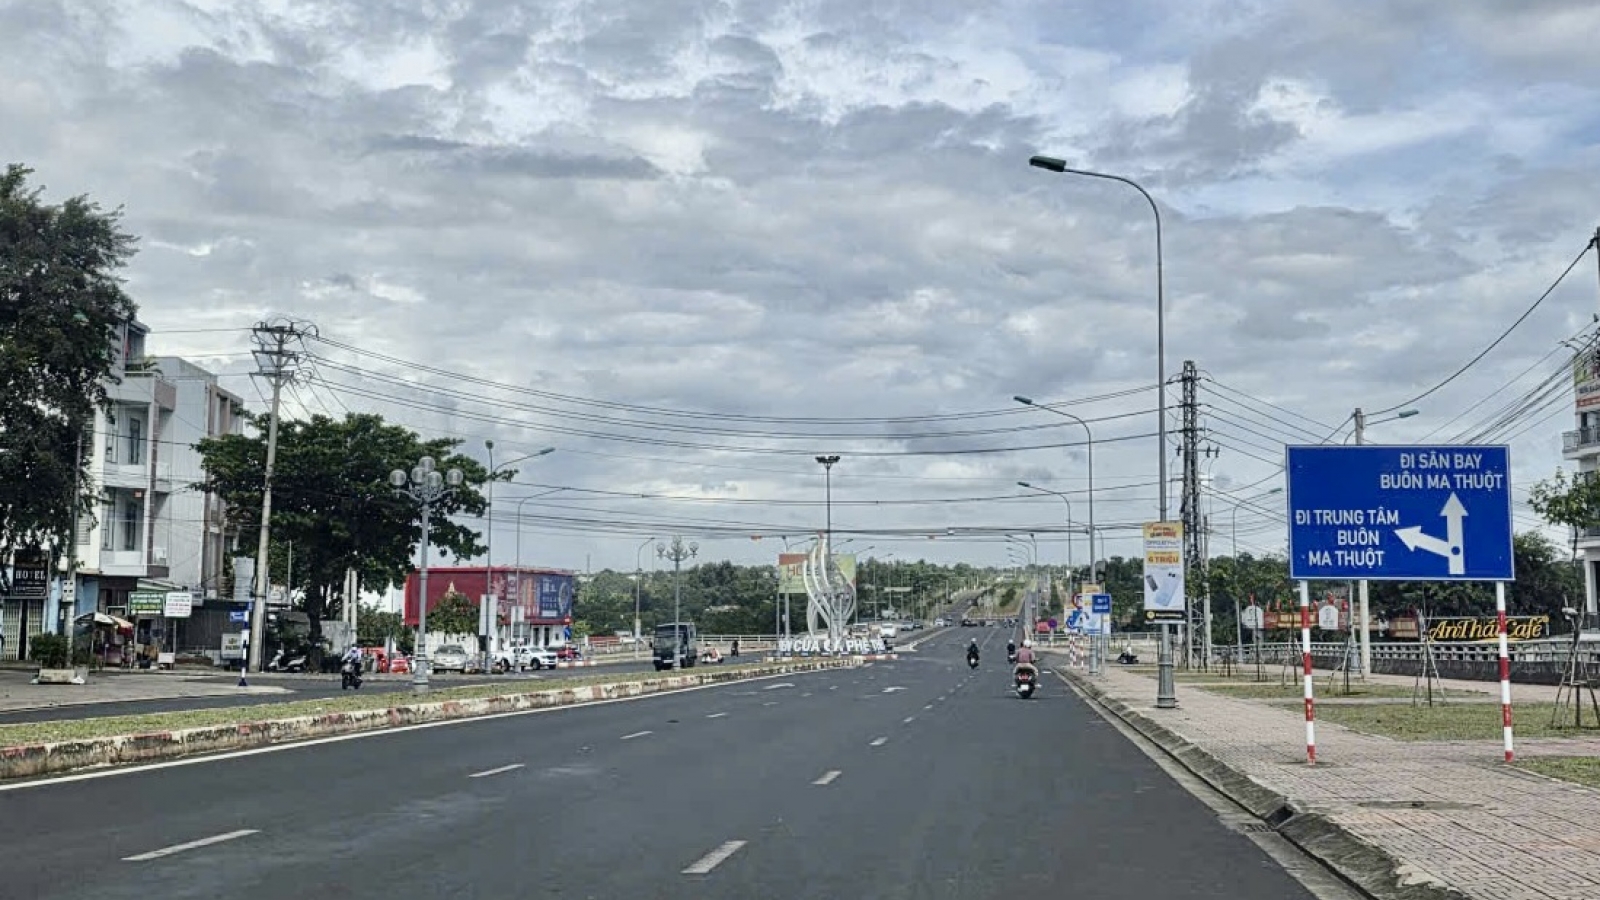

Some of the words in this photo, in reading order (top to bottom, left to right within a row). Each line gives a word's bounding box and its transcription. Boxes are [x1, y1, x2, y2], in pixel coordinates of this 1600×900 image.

[1400, 453, 1415, 469] ĐI
[1419, 450, 1449, 469] SÂN
[1453, 453, 1482, 469] BAY
[1380, 471, 1423, 489] BUÔN
[1427, 474, 1451, 489] MA
[1453, 470, 1503, 492] THUỘT
[1295, 510, 1311, 525] ĐI
[1313, 509, 1364, 525] TRUNG
[1366, 506, 1399, 525] TÂM
[1337, 527, 1380, 546] BUÔN
[1308, 551, 1332, 566] MA
[1335, 549, 1385, 569] THUỘT
[15, 570, 46, 581] HOTEL
